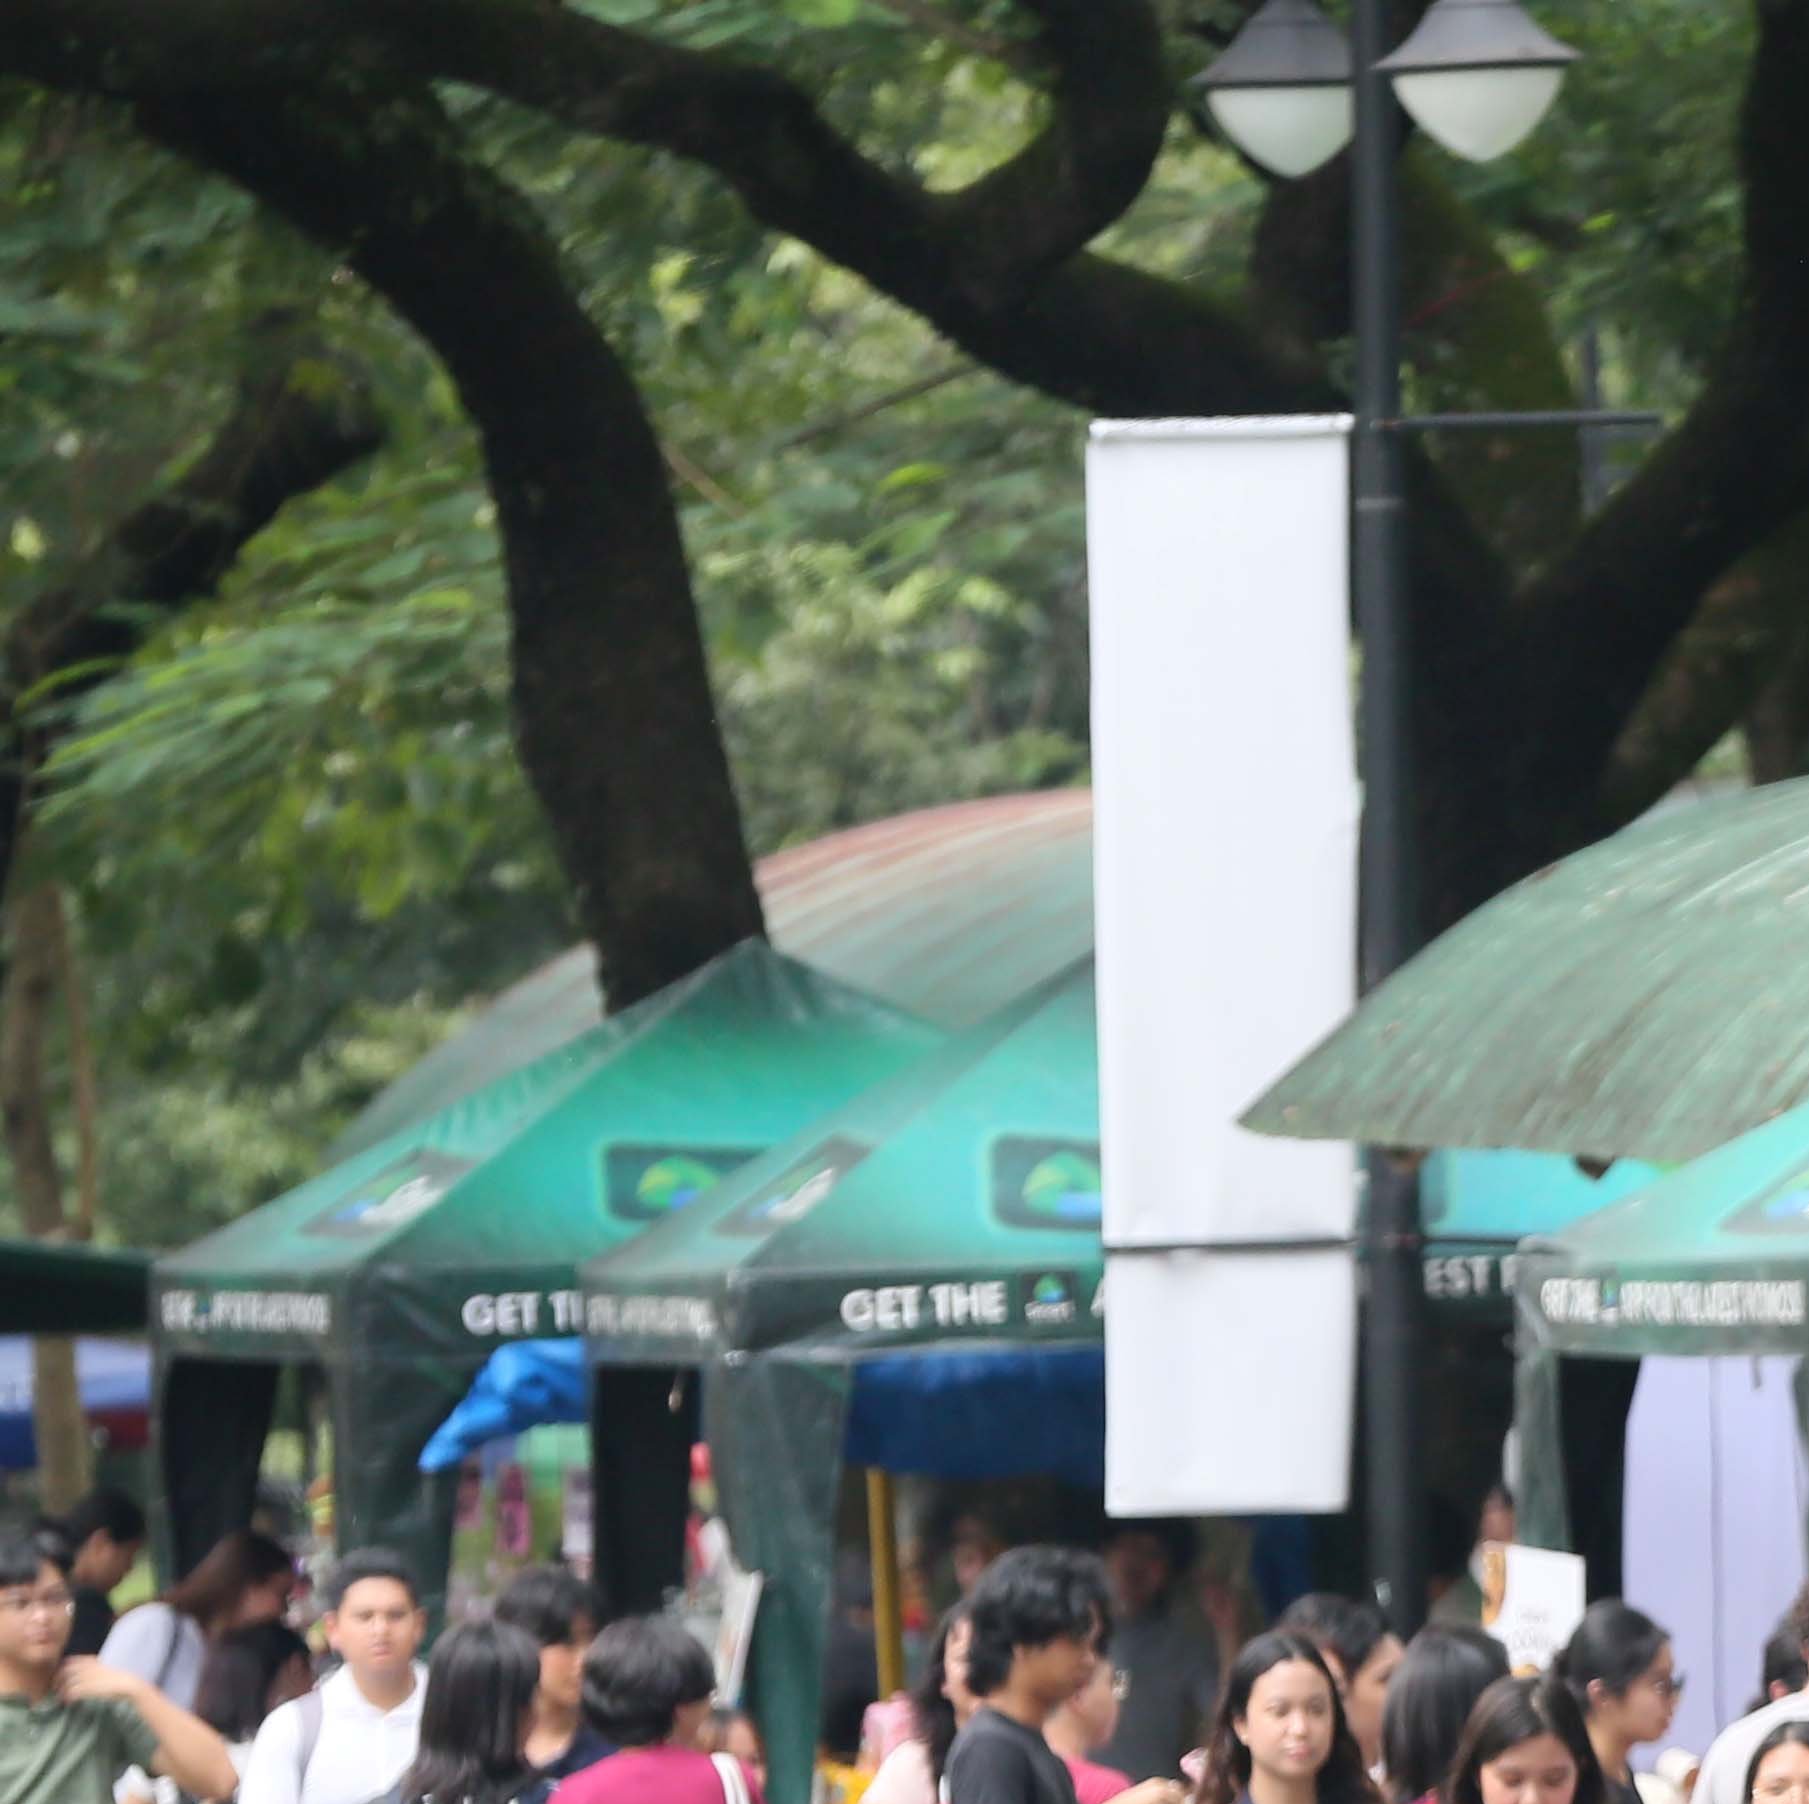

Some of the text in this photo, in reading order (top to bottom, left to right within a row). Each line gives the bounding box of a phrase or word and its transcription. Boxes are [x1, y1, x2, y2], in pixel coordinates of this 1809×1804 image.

[1424, 1255, 1490, 1298] EST
[462, 1293, 540, 1336] GET
[841, 1281, 1006, 1332] GET THE
